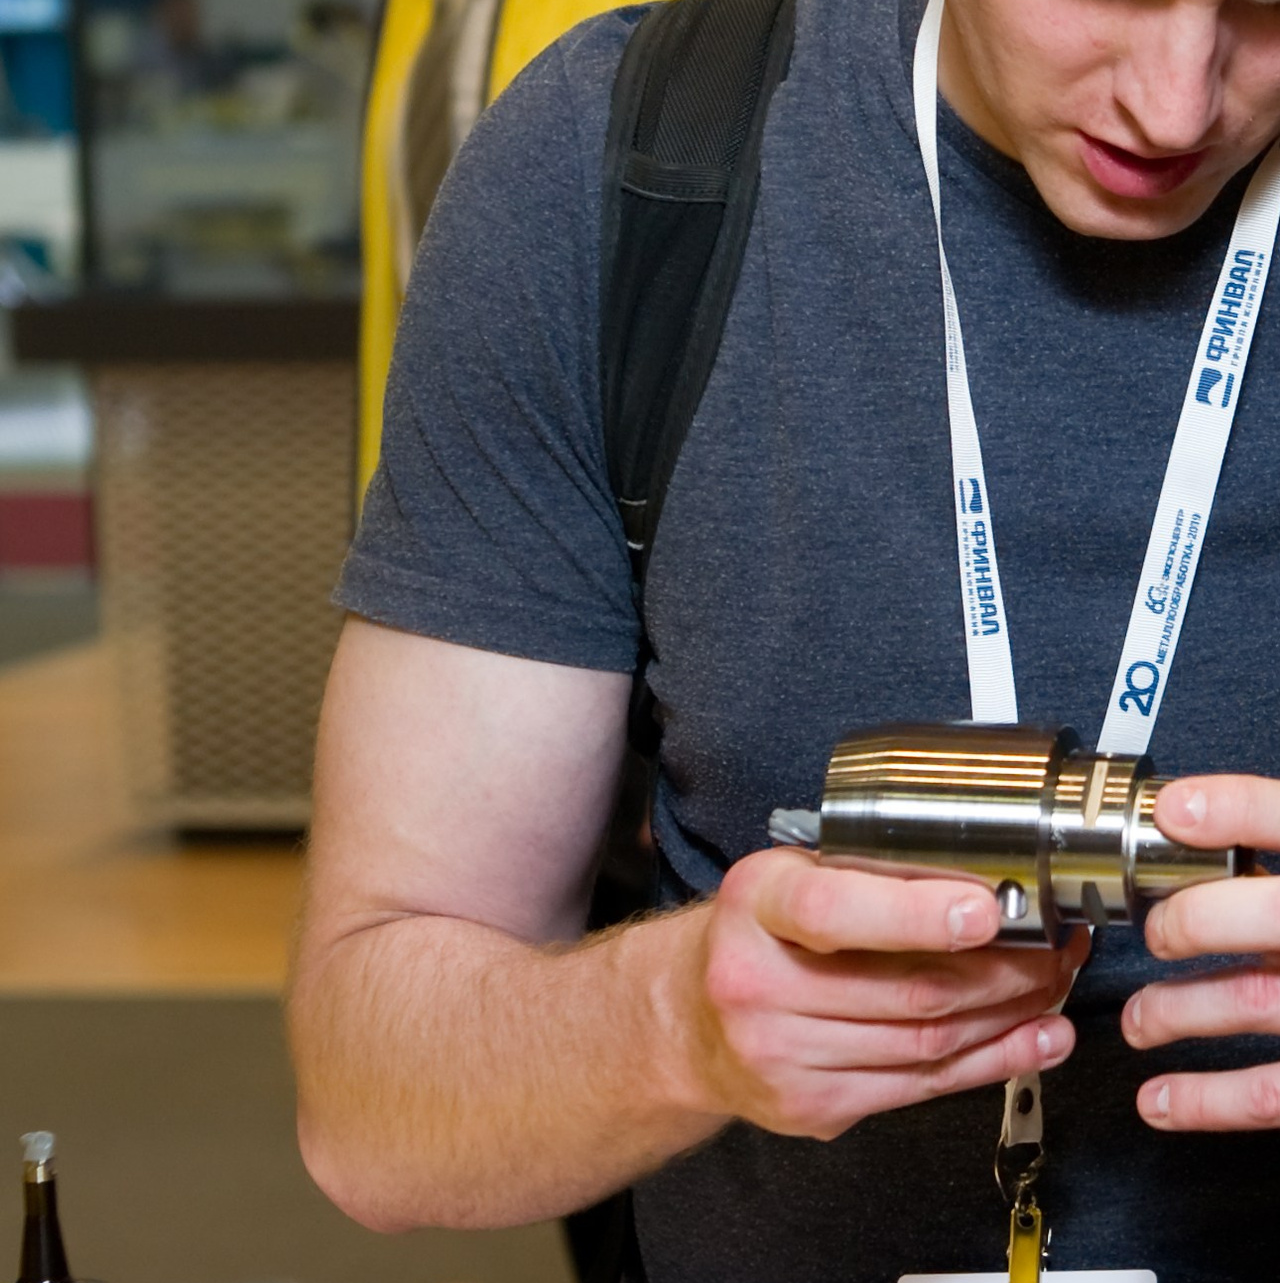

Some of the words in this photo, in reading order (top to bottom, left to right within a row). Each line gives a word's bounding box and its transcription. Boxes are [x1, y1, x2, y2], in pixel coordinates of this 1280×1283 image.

[1206, 249, 1256, 362] ФИНВАЛ
[971, 520, 1000, 636] ФИНВАЛ
[1119, 660, 1160, 717] 20
